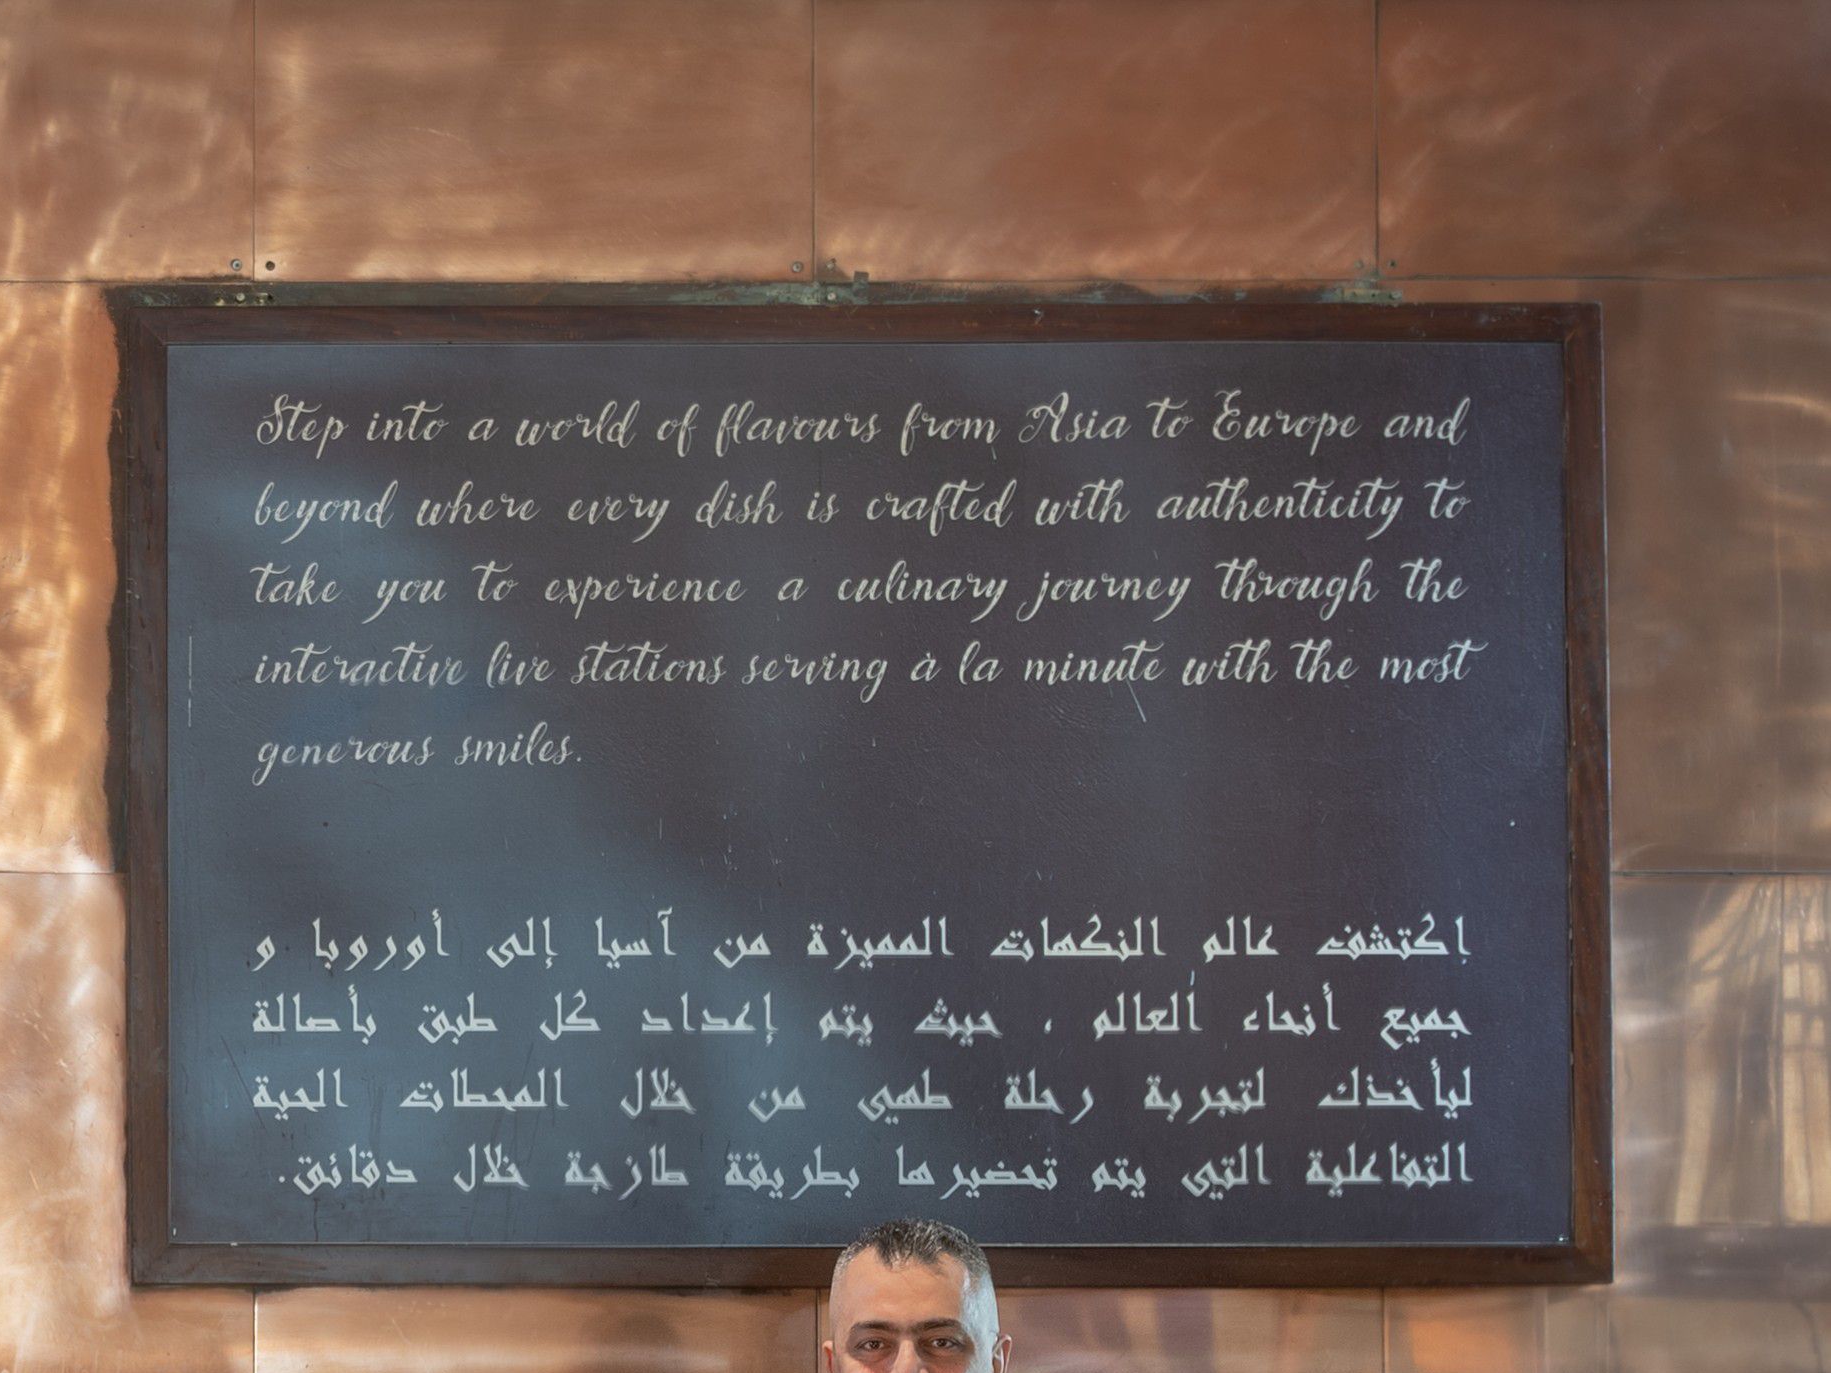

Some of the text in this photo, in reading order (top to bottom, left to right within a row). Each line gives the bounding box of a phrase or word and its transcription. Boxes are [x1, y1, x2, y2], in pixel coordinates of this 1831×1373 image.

[256, 389, 1471, 460] Step into a world of flavours from Asia to Europe and
[254, 476, 1472, 545] beyond where every dish is crafted with authenticity to
[249, 556, 1469, 625] take you to experience a culinary journey through the
[254, 637, 1490, 704] interactive live stations serving à la minute with the most
[251, 721, 582, 787] generous smiles.
[251, 935, 276, 972] و
[312, 908, 450, 972] أوروبا
[485, 916, 559, 970] إلى
[594, 906, 677, 970] آسيا
[712, 932, 772, 969] من
[806, 915, 955, 971] المميزة
[989, 913, 1167, 963] النكهات
[1202, 914, 1280, 964] عالم
[252, 983, 377, 1046] بأصالة
[417, 991, 499, 1046] طبق
[538, 988, 602, 1042] كل
[641, 991, 779, 1046] إعداد
[818, 1004, 874, 1047] يتم
[913, 997, 1003, 1048] حيث
[1092, 990, 1203, 1042] العالم
[1242, 981, 1342, 1038] أنحاء
[1379, 1006, 1473, 1051] جميع
[252, 1057, 1474, 1125] ليأخذك لتجربة رحلة طهي من خلال المحطات الحية
[453, 1142, 530, 1193] خلال
[564, 1143, 690, 1201] طازجة
[724, 1144, 860, 1201] بطريقة
[895, 1144, 1058, 1201] تحضيرها
[1091, 1157, 1147, 1199] يتم
[1180, 1142, 1272, 1201] التي
[1304, 1141, 1474, 1198] التفاعلية
